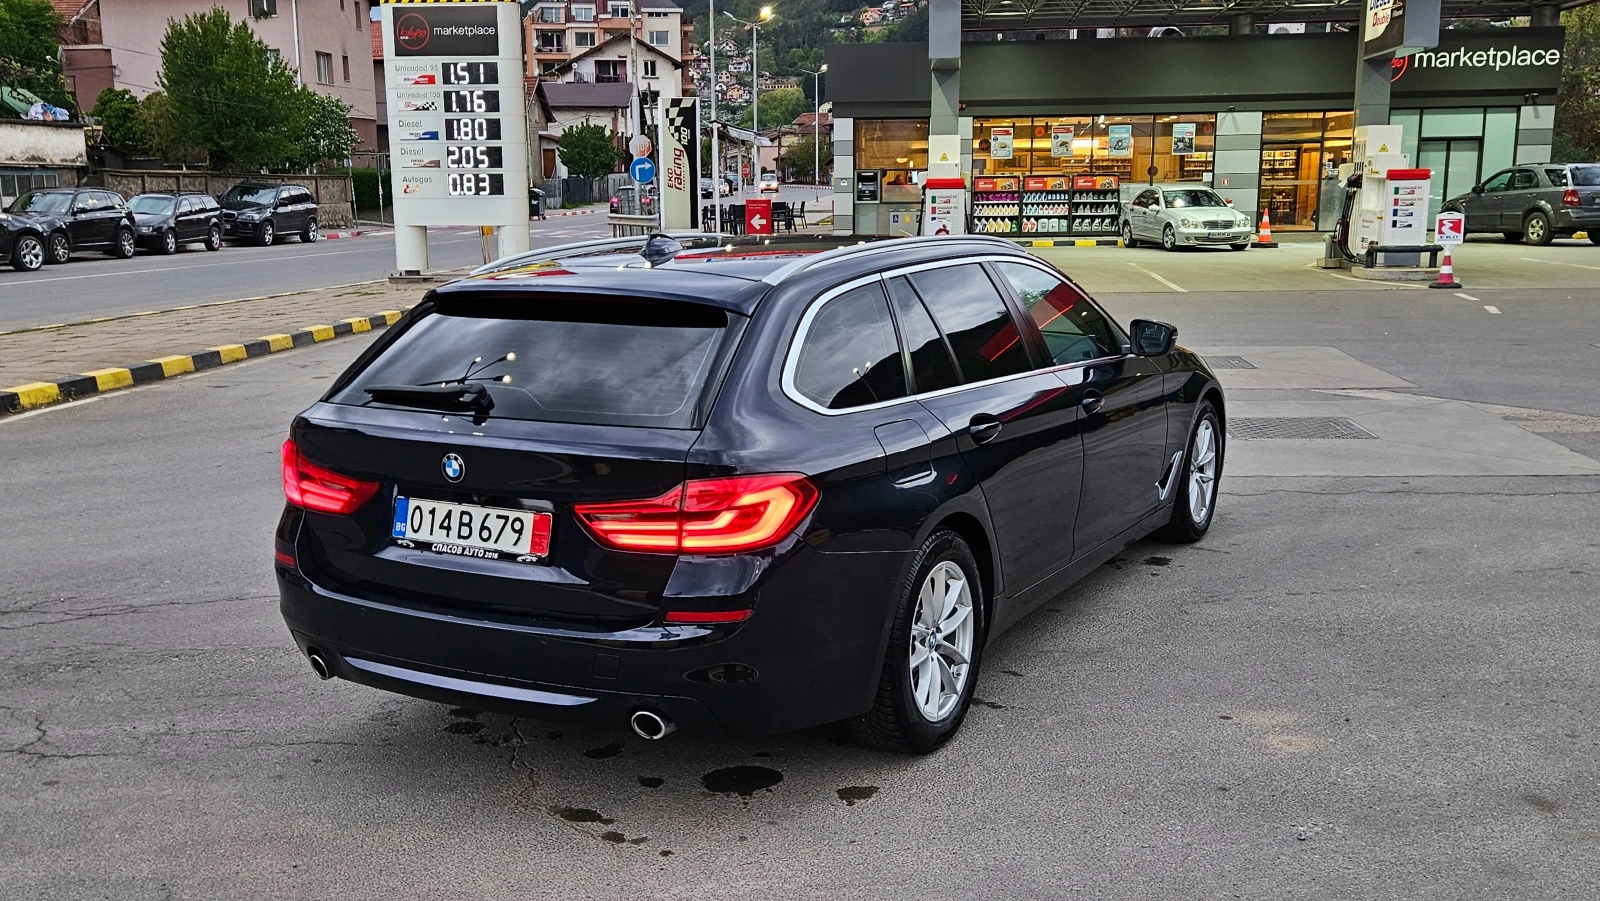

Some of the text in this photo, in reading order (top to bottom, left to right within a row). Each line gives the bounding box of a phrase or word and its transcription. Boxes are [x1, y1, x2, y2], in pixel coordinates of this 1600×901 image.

[1372, 12, 1390, 27] Double
[433, 25, 496, 37] marketplace
[1414, 45, 1560, 71] marketplace
[394, 64, 428, 72] Unleaded
[450, 62, 485, 85] 1.51
[396, 91, 441, 99] Unleaded 100
[451, 90, 486, 113] 1.76
[398, 119, 422, 128] Diesel
[453, 118, 488, 141] 1.80
[680, 126, 689, 146] 100
[400, 147, 424, 156] Diesel
[447, 146, 489, 168] 2.05
[673, 147, 685, 191] racing
[402, 175, 433, 185] Autogas
[448, 173, 490, 196] 0.83
[396, 522, 406, 531] BG
[431, 543, 499, 559] СПАСОВ АУТО 2016
